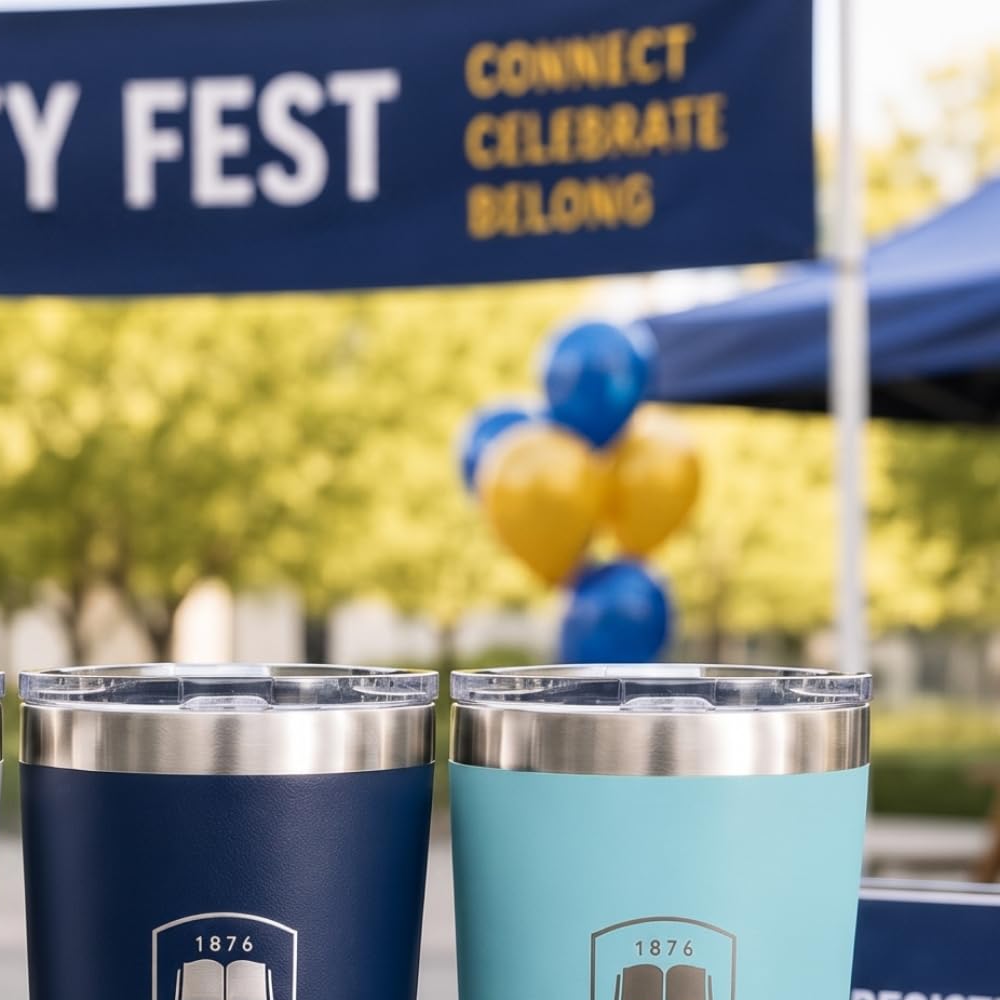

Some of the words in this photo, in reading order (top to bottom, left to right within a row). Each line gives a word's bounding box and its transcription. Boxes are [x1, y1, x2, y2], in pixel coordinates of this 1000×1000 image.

[465, 24, 694, 98] CONNECT
[122, 68, 401, 209] FEST
[465, 93, 727, 169] CELEBRATE
[467, 173, 655, 239] BELONG
[195, 935, 254, 952] 1876
[634, 939, 694, 957] 1876
